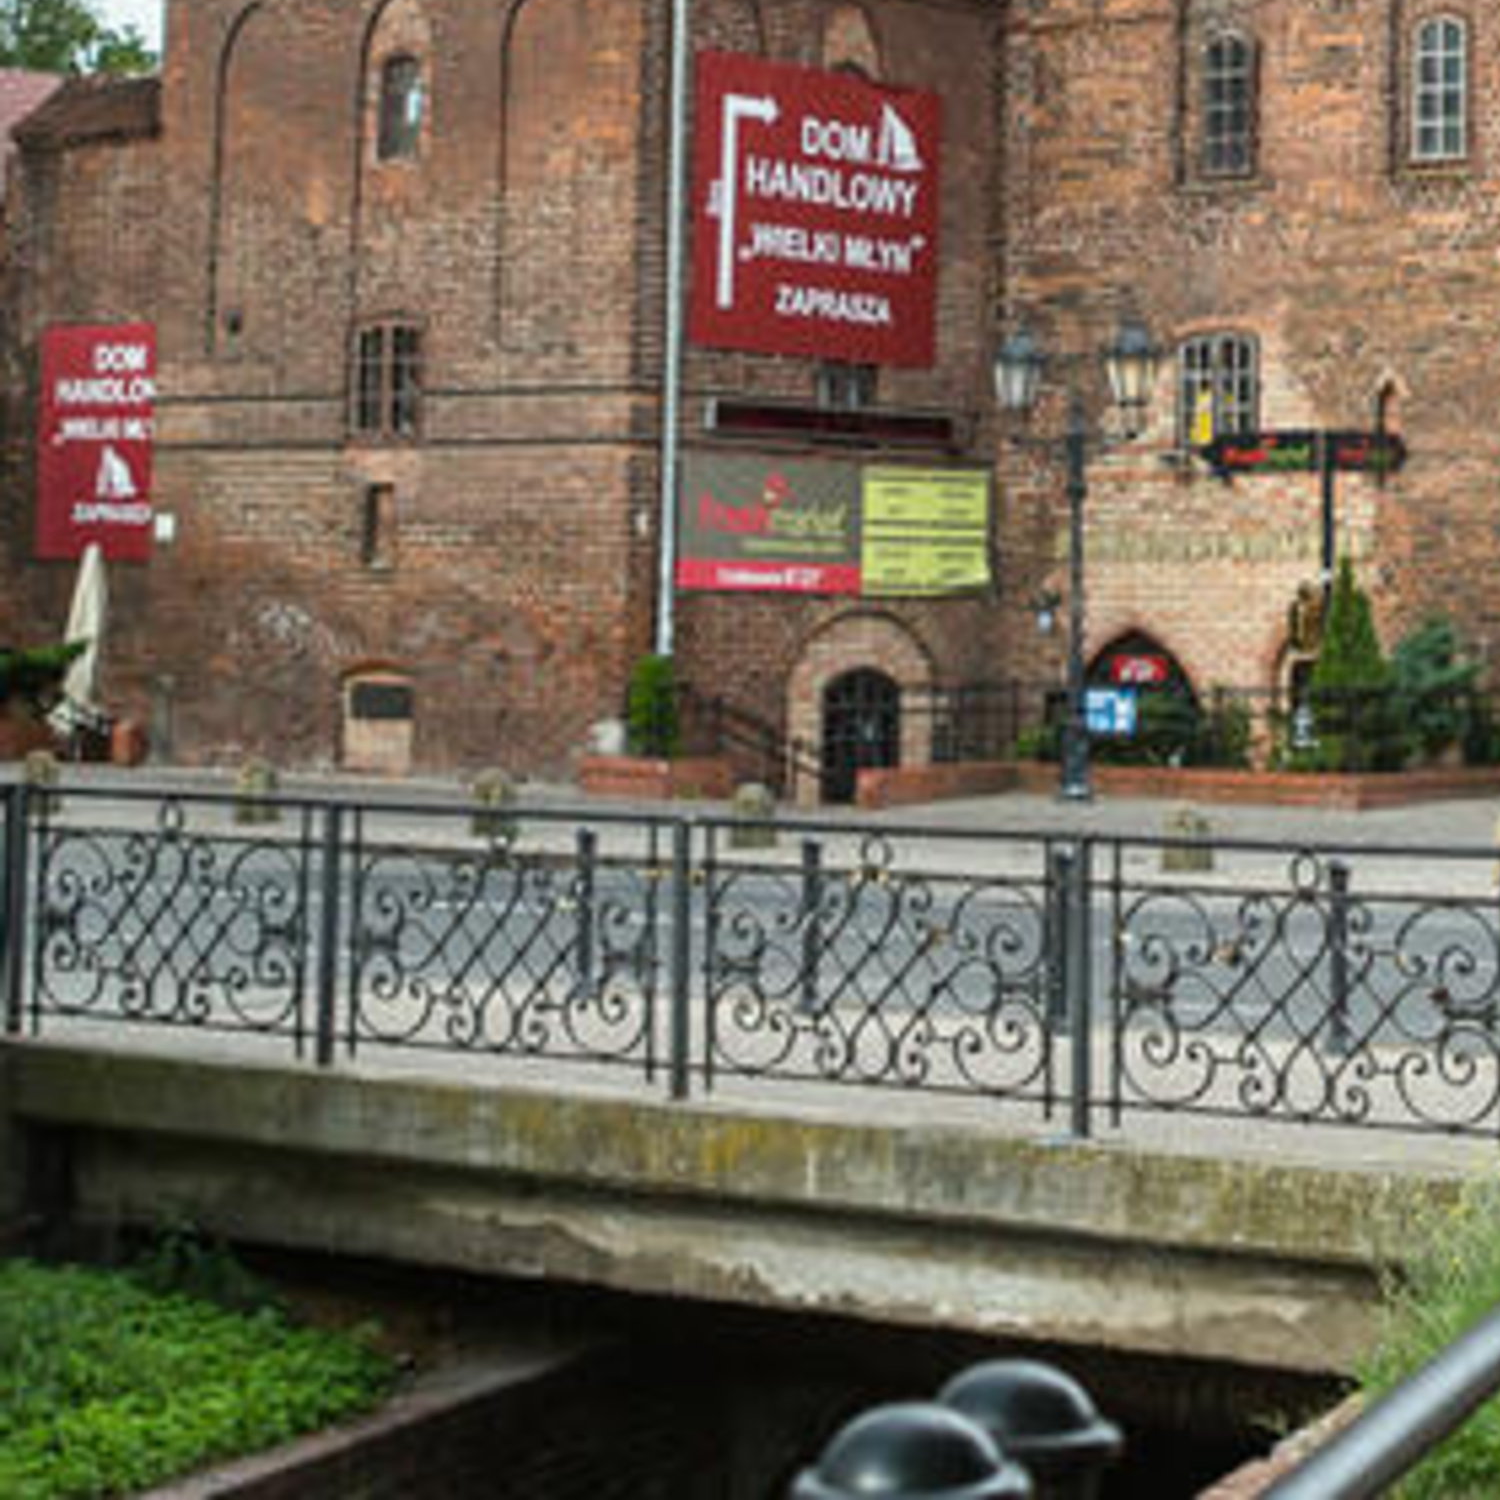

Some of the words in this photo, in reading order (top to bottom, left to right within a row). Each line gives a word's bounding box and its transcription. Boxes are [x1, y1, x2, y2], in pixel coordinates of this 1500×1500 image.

[802, 116, 870, 161] DOM
[746, 154, 917, 217] HANDLOWY
[775, 283, 892, 325] ZAPRASZA
[95, 344, 148, 373] DOM
